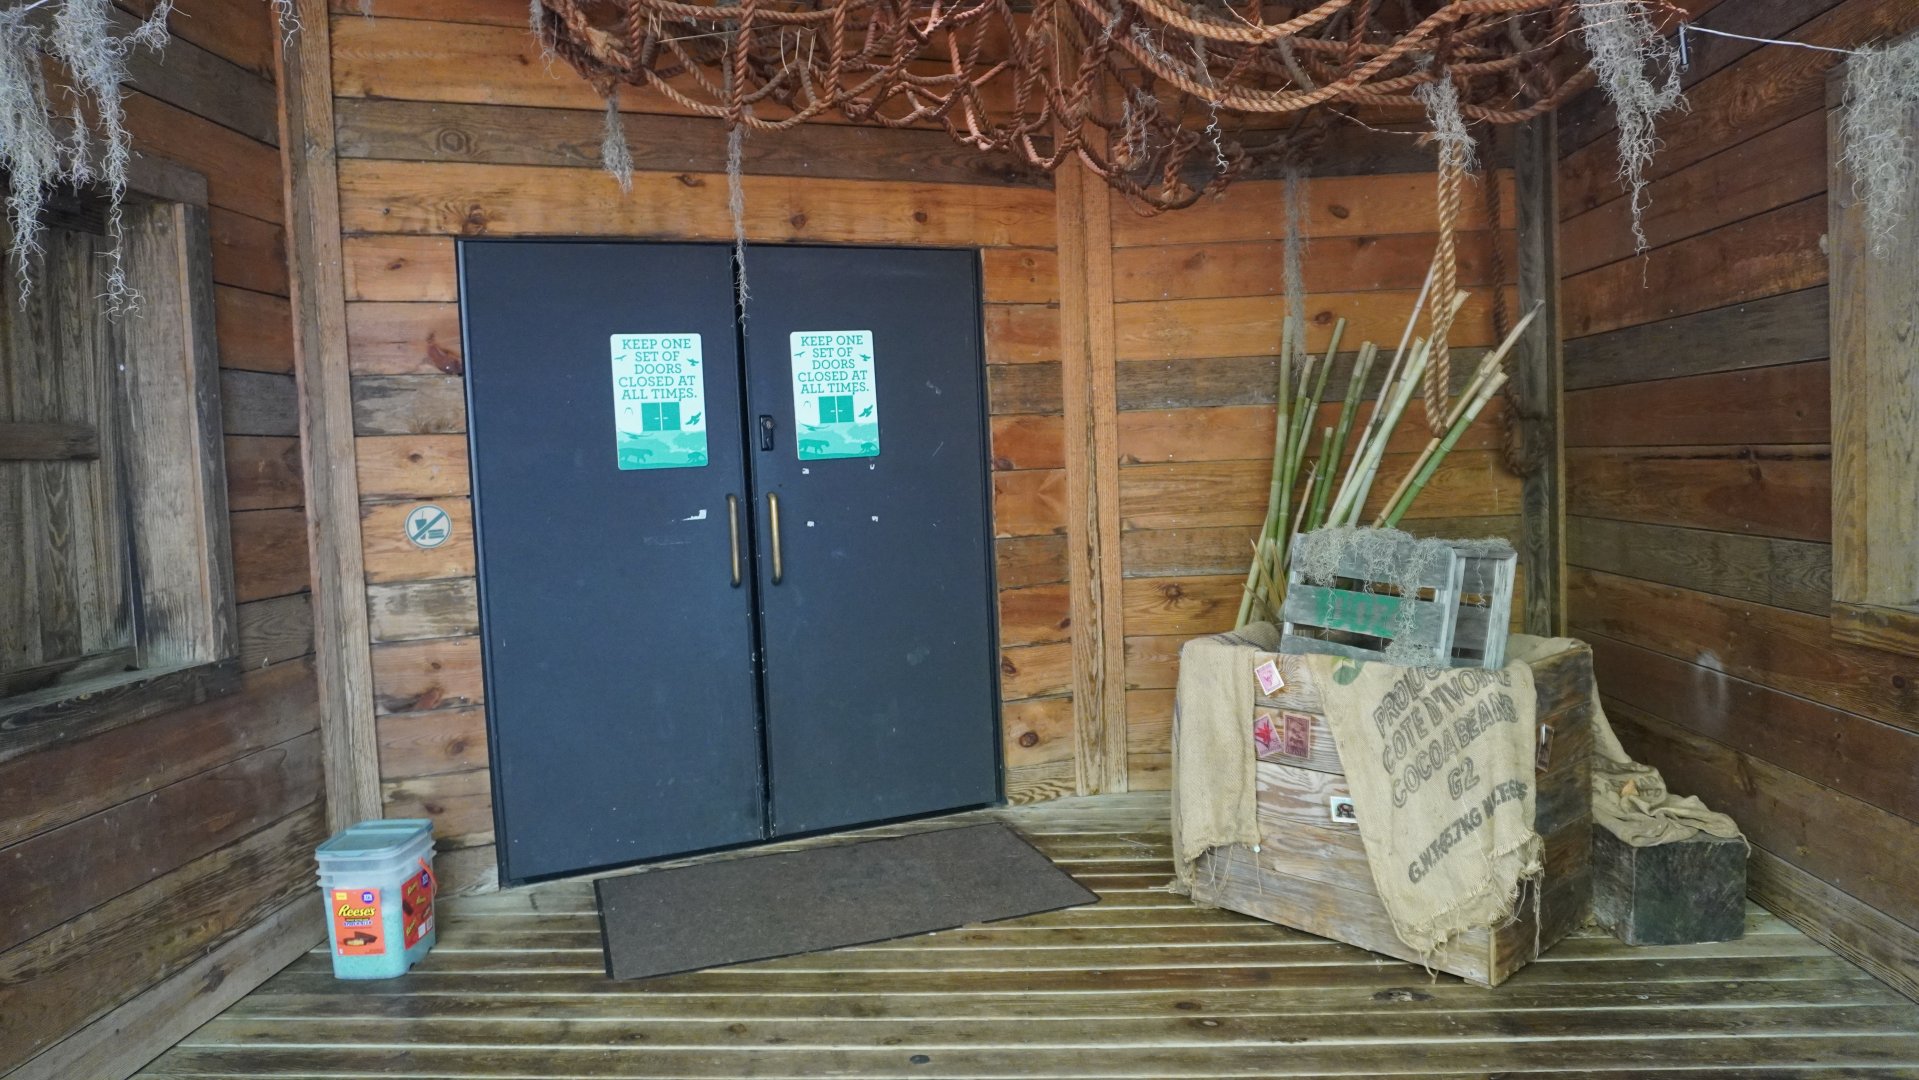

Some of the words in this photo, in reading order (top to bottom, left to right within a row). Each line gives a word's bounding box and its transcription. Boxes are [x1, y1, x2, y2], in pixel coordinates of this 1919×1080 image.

[622, 338, 658, 350] KEEP
[661, 338, 691, 349] ONE
[800, 336, 833, 346] KEEP
[836, 335, 864, 345] ONE
[635, 351, 659, 362] SET
[661, 351, 680, 361] OF
[812, 347, 834, 358] SET
[836, 347, 854, 357] OF
[634, 363, 682, 374] DOORS
[812, 359, 855, 370] DOORS
[618, 376, 674, 387] CLOSED
[677, 375, 696, 386] AT
[797, 371, 848, 382] CLOSED
[851, 370, 868, 380] AT
[621, 389, 648, 400] ALL
[651, 388, 697, 400] TIMES.
[801, 384, 824, 394] ALL
[827, 382, 870, 393] TIMES.
[1391, 728, 1460, 808] COCOA
[1453, 692, 1519, 749] BEANS
[1447, 756, 1480, 800] G2
